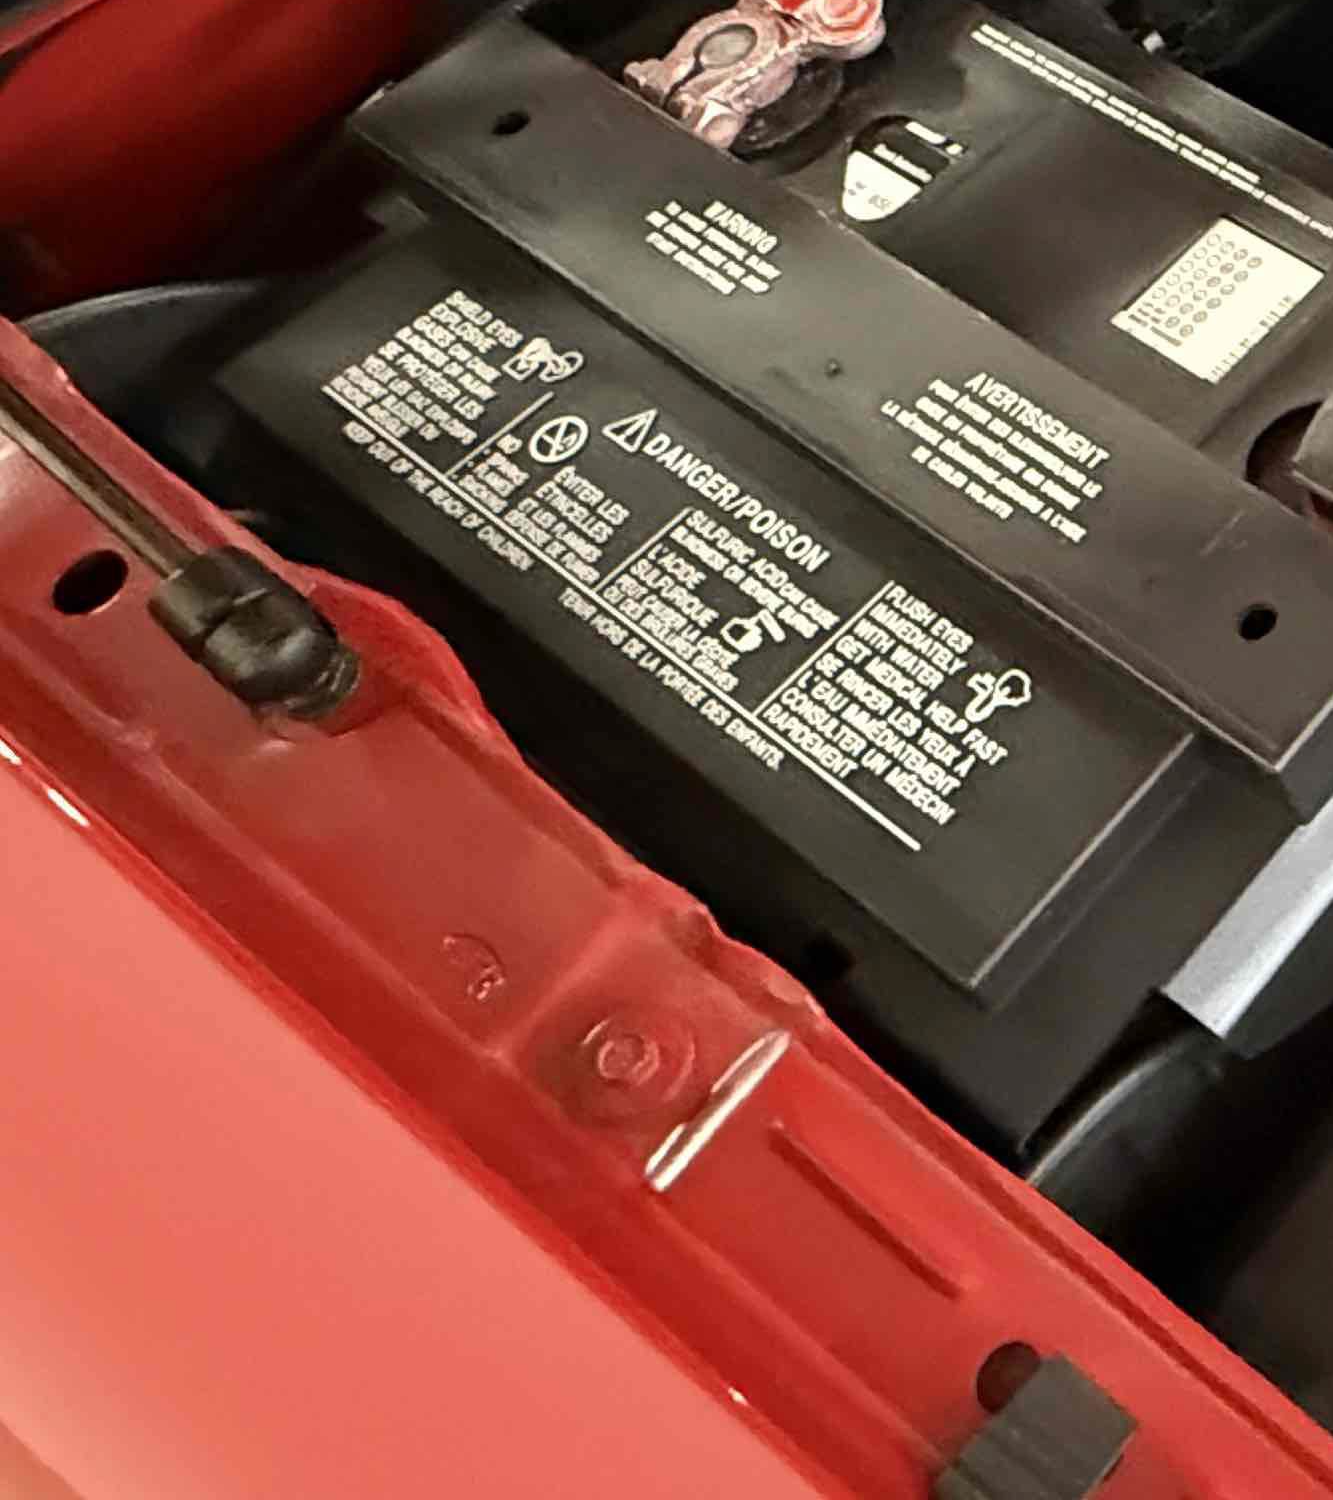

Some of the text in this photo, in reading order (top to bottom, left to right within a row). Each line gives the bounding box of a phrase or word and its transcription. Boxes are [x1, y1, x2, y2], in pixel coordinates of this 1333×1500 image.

[704, 200, 779, 255] WARNING
[453, 396, 484, 420] LES
[964, 372, 1110, 469] AVERTISSEMENT
[597, 499, 629, 525] LES
[642, 432, 830, 572] DANGER/POISON
[647, 543, 706, 589] L'ACIDE
[686, 510, 756, 564] SULFURIC
[749, 558, 789, 588] ACID
[630, 559, 719, 628] SULFURIQUE
[885, 586, 973, 654] FLUSH EYES
[853, 618, 944, 691] WITH WATER
[869, 602, 967, 675] IMMEDIATELY
[638, 652, 661, 672] LA
[700, 699, 731, 726] DES
[815, 653, 844, 678] SE
[836, 668, 893, 715] RINCER
[886, 706, 922, 737] LES
[917, 727, 962, 766] YEUX
[835, 635, 1008, 765] GET MEDICAL HELP FAST
[762, 703, 858, 778] RAPIDEMENT
[781, 687, 955, 825] CONSULTER UN MÉDECIN
[797, 670, 961, 796] L'EAU IMMÉDIATEMENT
